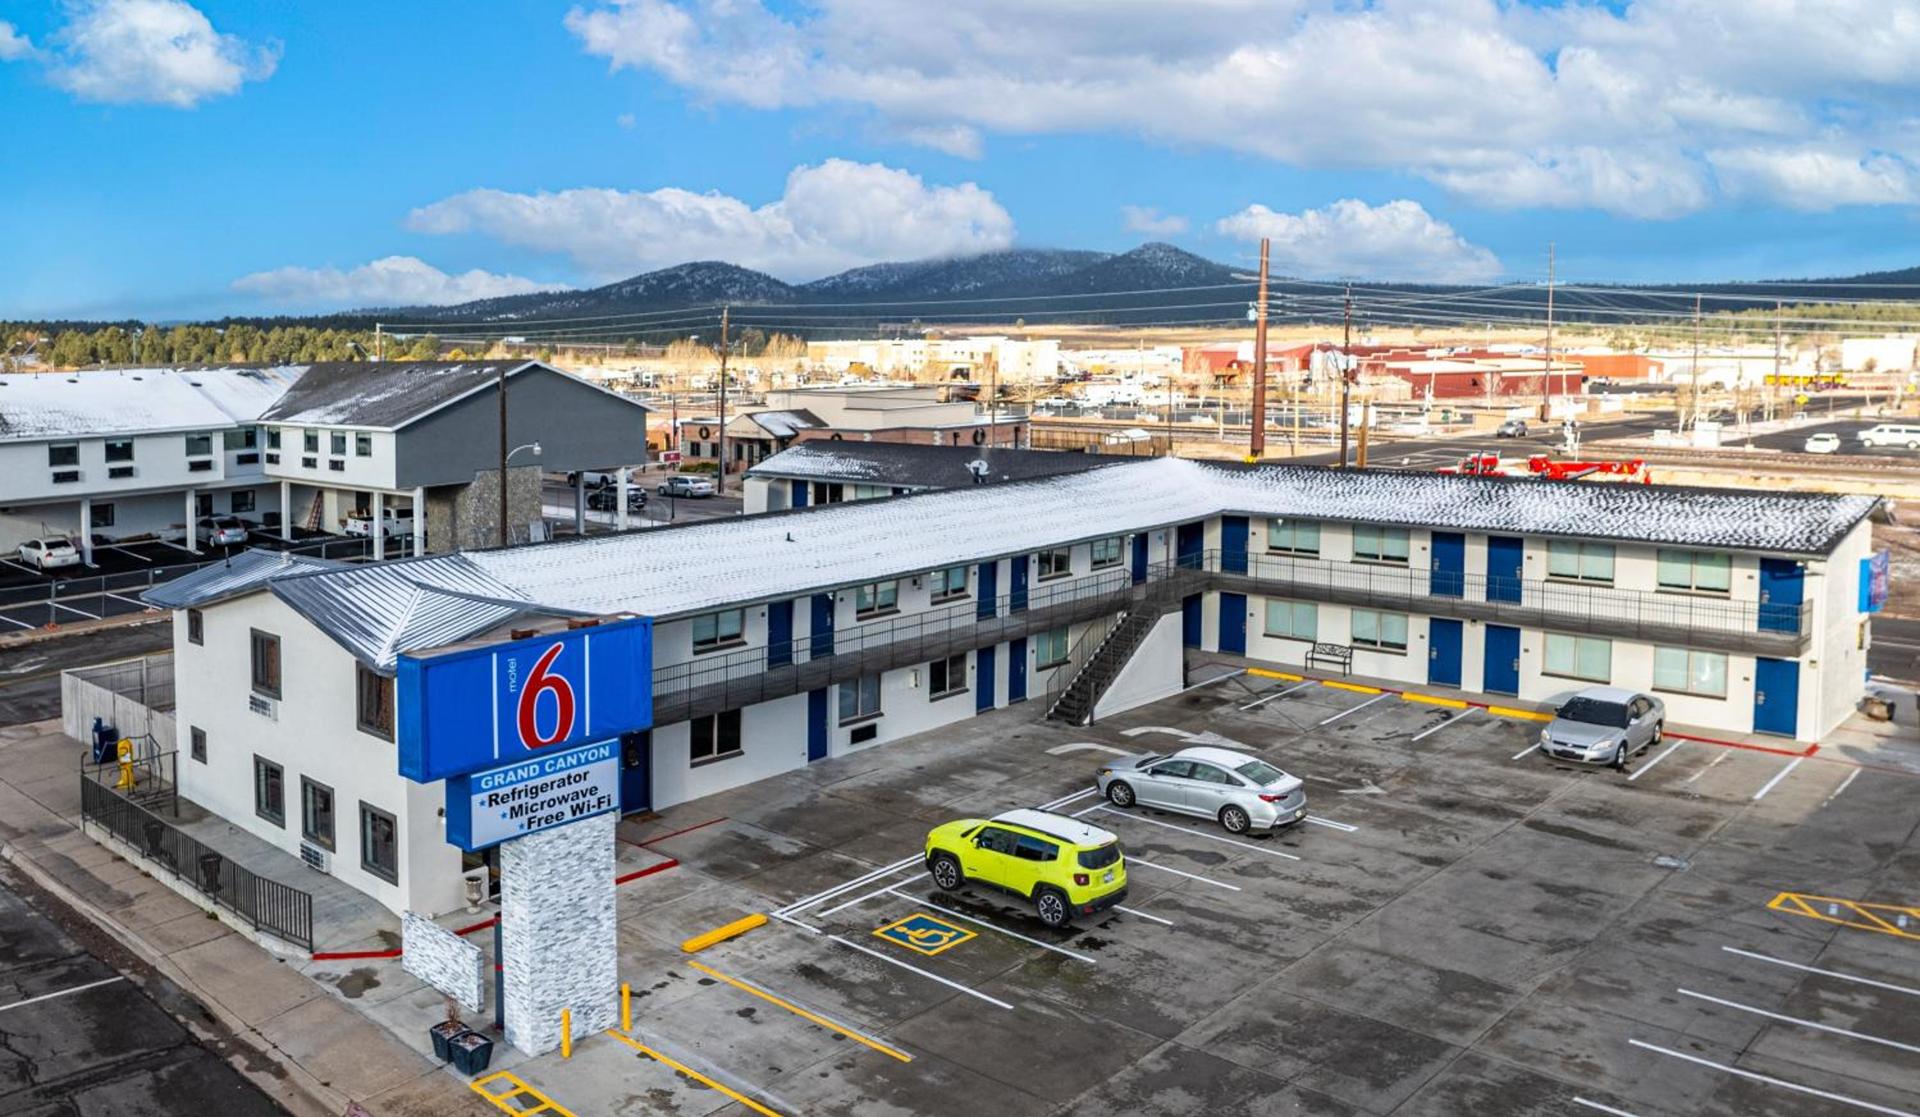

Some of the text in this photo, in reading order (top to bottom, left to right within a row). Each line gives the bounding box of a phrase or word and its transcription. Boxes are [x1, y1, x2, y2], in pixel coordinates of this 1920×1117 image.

[507, 658, 517, 693] motel
[516, 641, 576, 750] 6
[481, 745, 610, 789] GRAND CANYON
[488, 770, 590, 808] Refrigerator
[509, 785, 599, 819] Microwave
[527, 794, 612, 830] Free Wi-Fi
